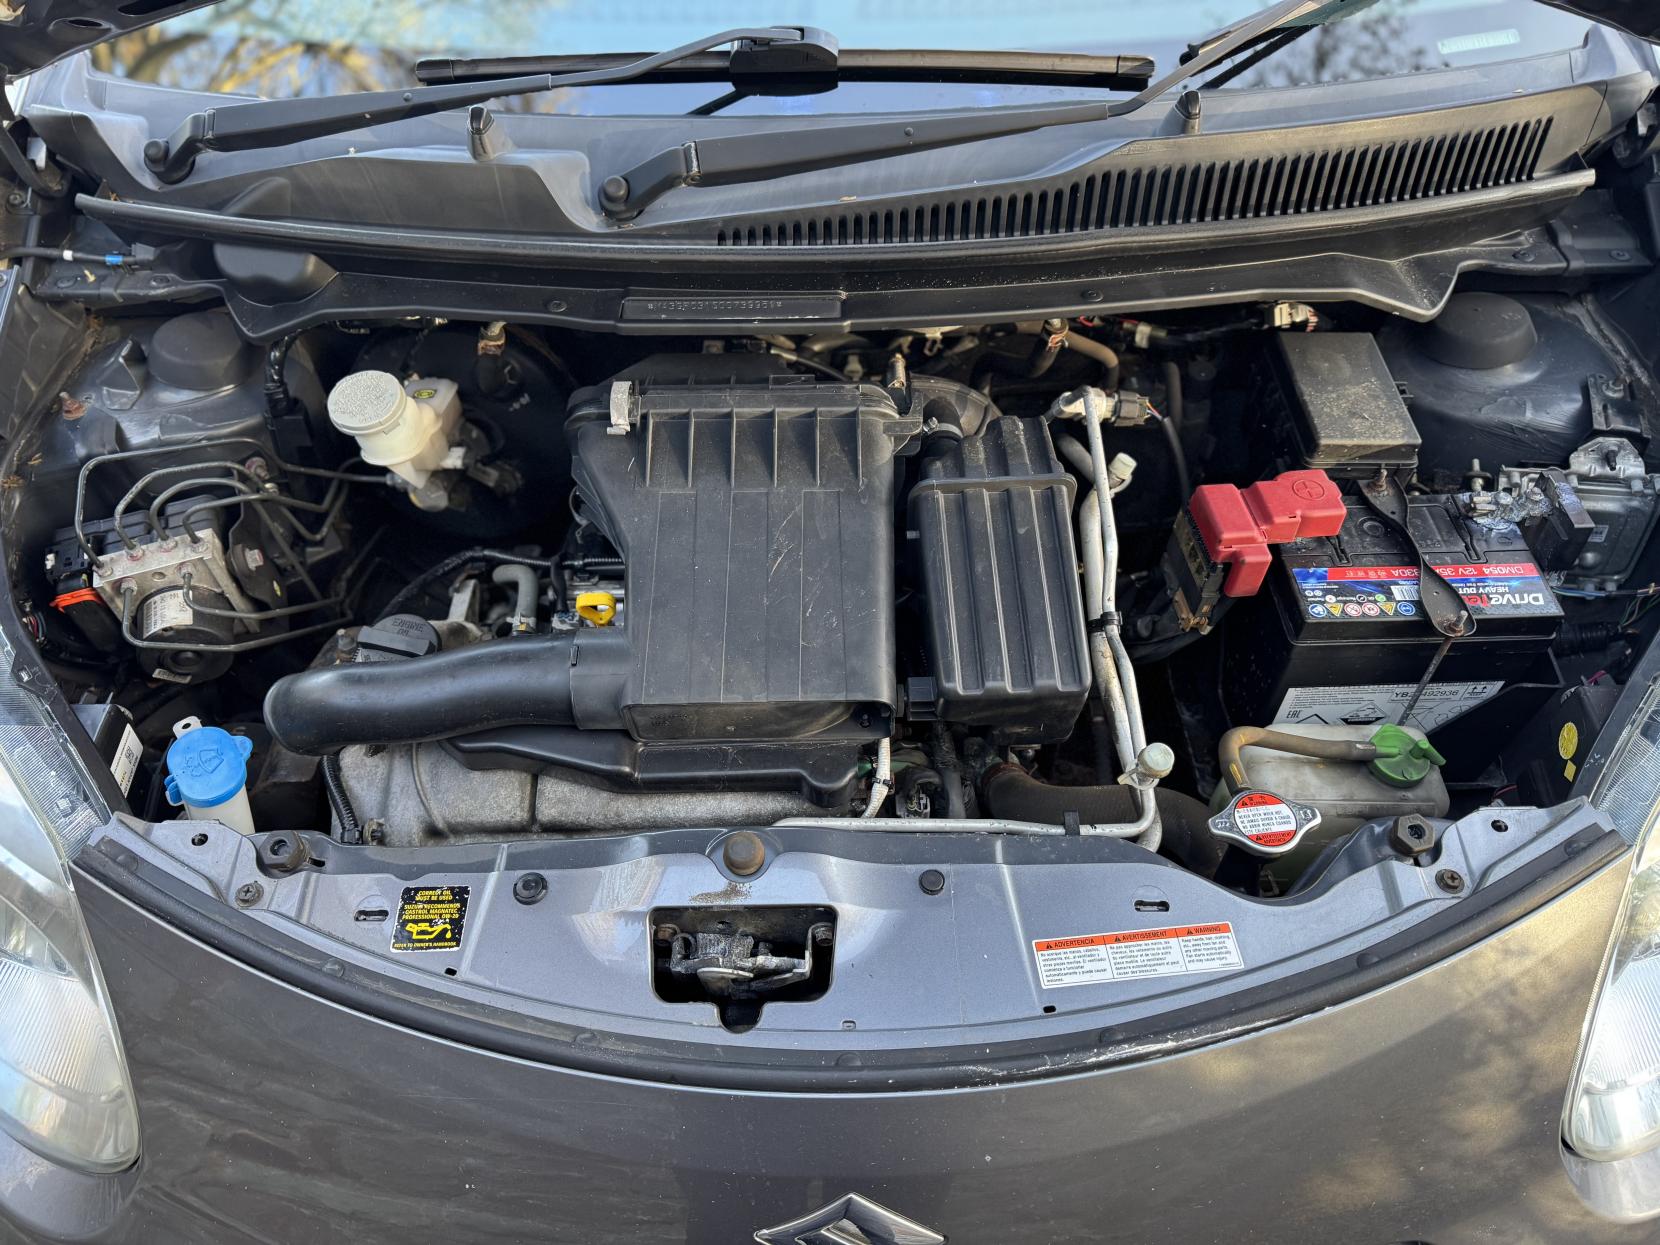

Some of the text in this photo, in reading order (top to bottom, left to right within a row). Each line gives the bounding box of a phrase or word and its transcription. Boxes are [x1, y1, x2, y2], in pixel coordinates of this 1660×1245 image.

[392, 617, 424, 632] ENGINE
[1193, 925, 1221, 933] WARNING
[1121, 930, 1167, 941] AVERTISSEMENT
[1053, 937, 1095, 947] ADVERTENCIA
